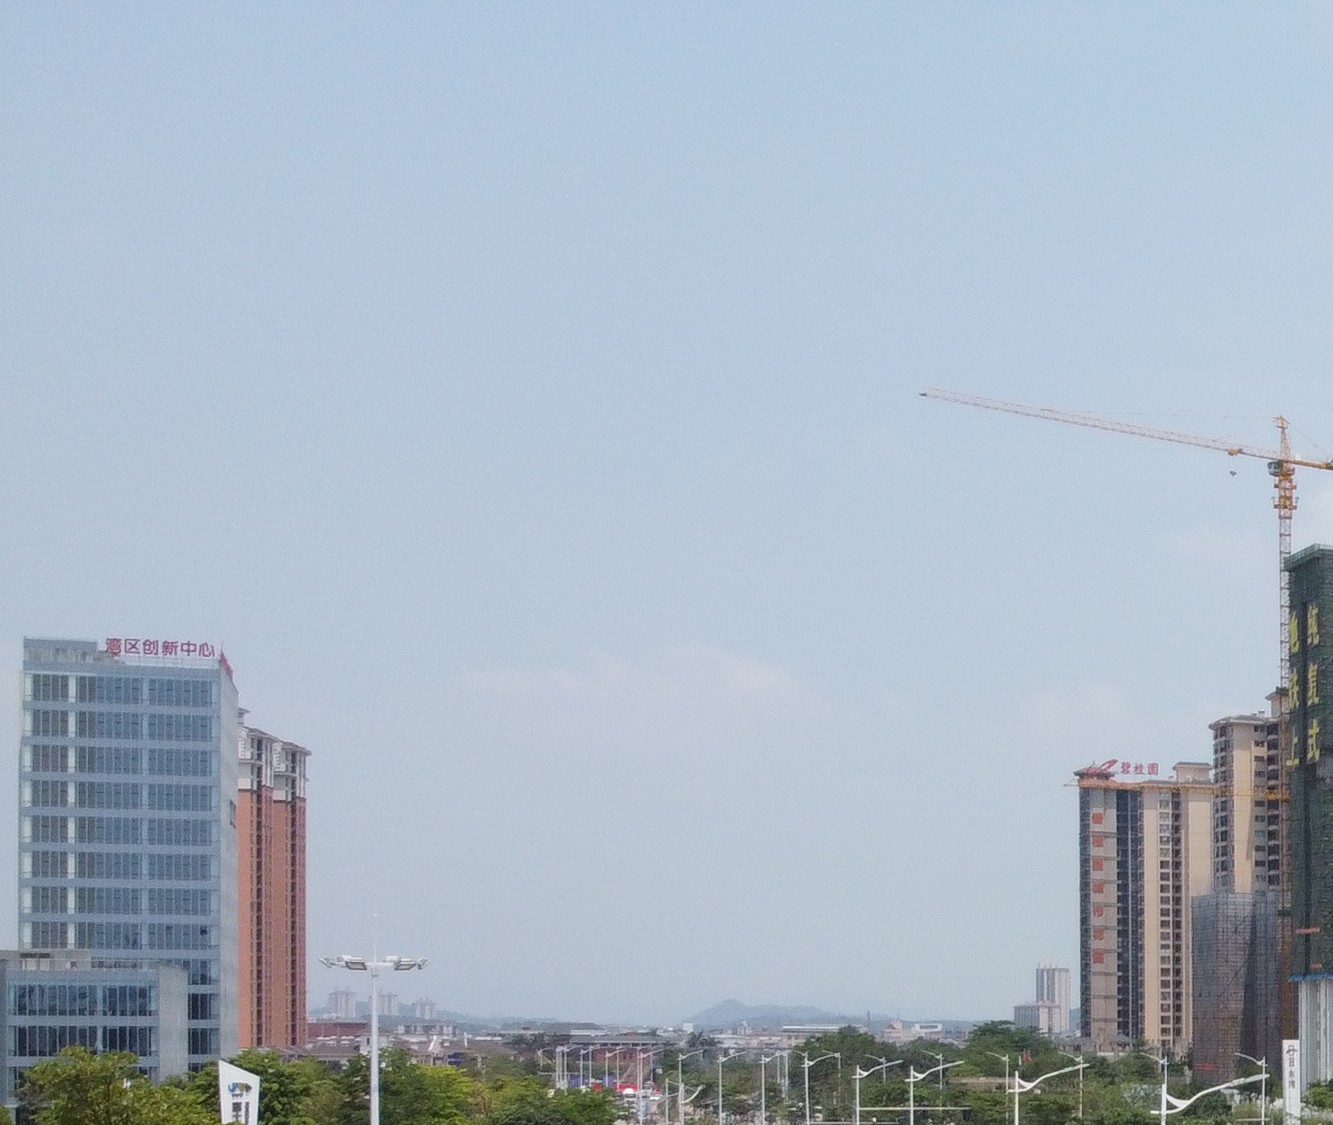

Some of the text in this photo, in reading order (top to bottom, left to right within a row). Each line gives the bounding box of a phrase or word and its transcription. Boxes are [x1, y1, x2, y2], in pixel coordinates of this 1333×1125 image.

[105, 637, 215, 658] 湾区创新中心
[1120, 760, 1159, 775] 碧桂园
